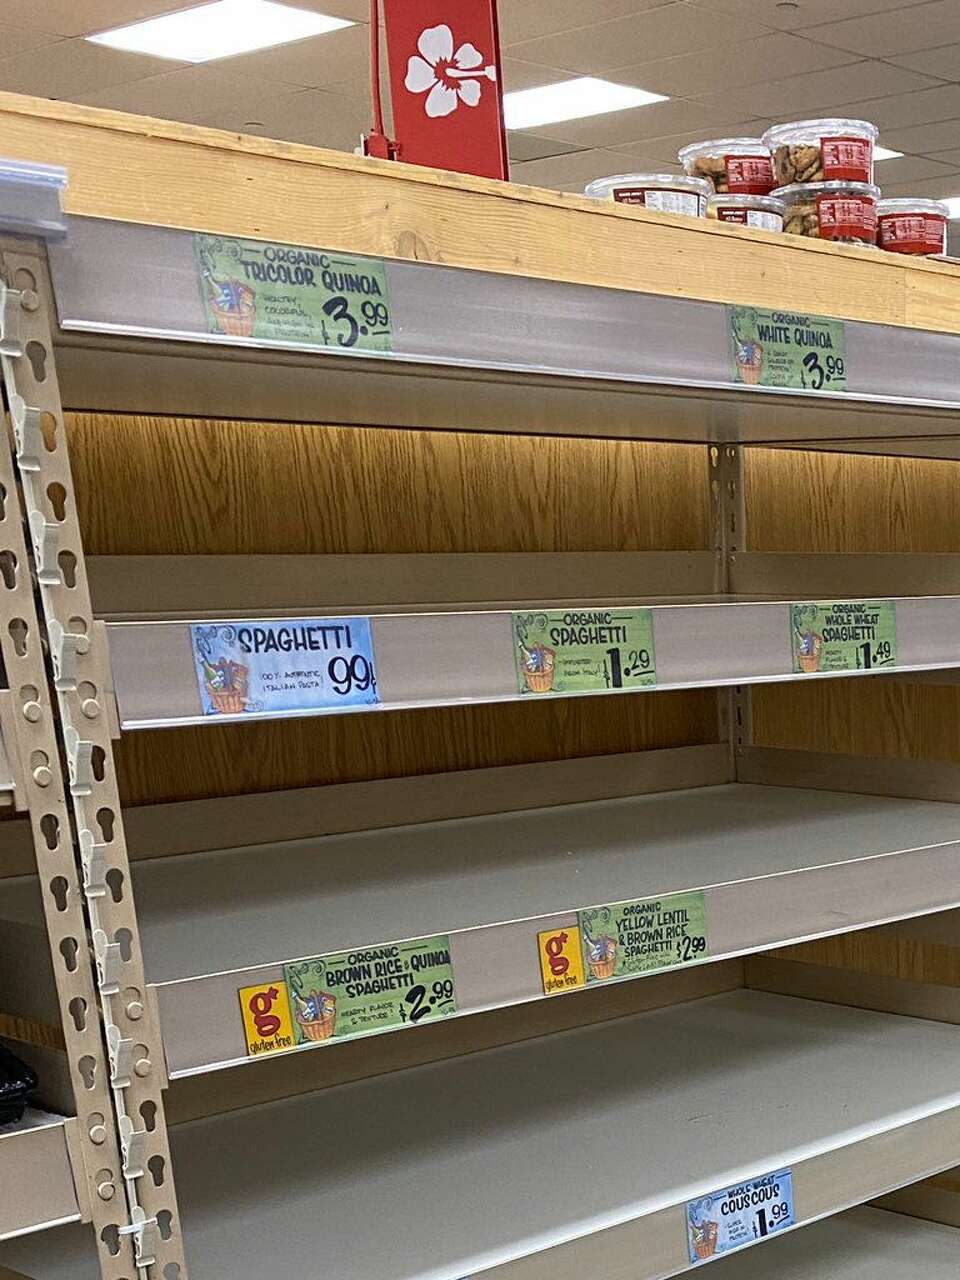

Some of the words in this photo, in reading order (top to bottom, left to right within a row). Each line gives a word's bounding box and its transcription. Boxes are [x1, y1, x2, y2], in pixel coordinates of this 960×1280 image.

[263, 246, 330, 268] ORGANIC
[241, 260, 316, 287] TRICOLOR
[321, 271, 383, 297] QUINOA
[321, 295, 390, 347] $3.99
[771, 312, 811, 328] ORGANIC
[757, 324, 791, 344] WHITE
[794, 327, 834, 349] QUINOA
[800, 352, 845, 389] $3.99
[562, 612, 613, 626] ORGANIC
[825, 614, 852, 625] WHOLE
[853, 614, 880, 625] WHEAT
[831, 603, 866, 614] ORGANIC
[238, 625, 352, 653] SPAGHETTI
[550, 626, 628, 646] SPAGHETTI
[821, 626, 875, 643] SPAGHETTI
[855, 641, 891, 669] $1.49
[602, 647, 651, 689] $1.29
[615, 916, 655, 933] YELLOW
[657, 909, 691, 926] LENTIL
[623, 902, 662, 916] ORGANIC
[627, 930, 665, 946] BROWN
[666, 924, 689, 938] RICE
[347, 946, 399, 966] ORGANIC
[624, 941, 673, 958] SPAGHETTI
[676, 936, 707, 961] $2.99
[325, 962, 373, 988] BROWN
[374, 959, 403, 979] RICE
[410, 950, 451, 970] QUINOA
[345, 974, 415, 999] SPAGHETTI
[398, 979, 454, 1024] $2.99
[249, 1037, 275, 1055] gluten
[274, 1033, 293, 1048] free
[727, 1184, 751, 1199] WHOLE
[752, 1174, 776, 1190] WHEAT
[721, 1183, 780, 1216] COUSCOUS
[752, 1202, 789, 1239] $1.99
